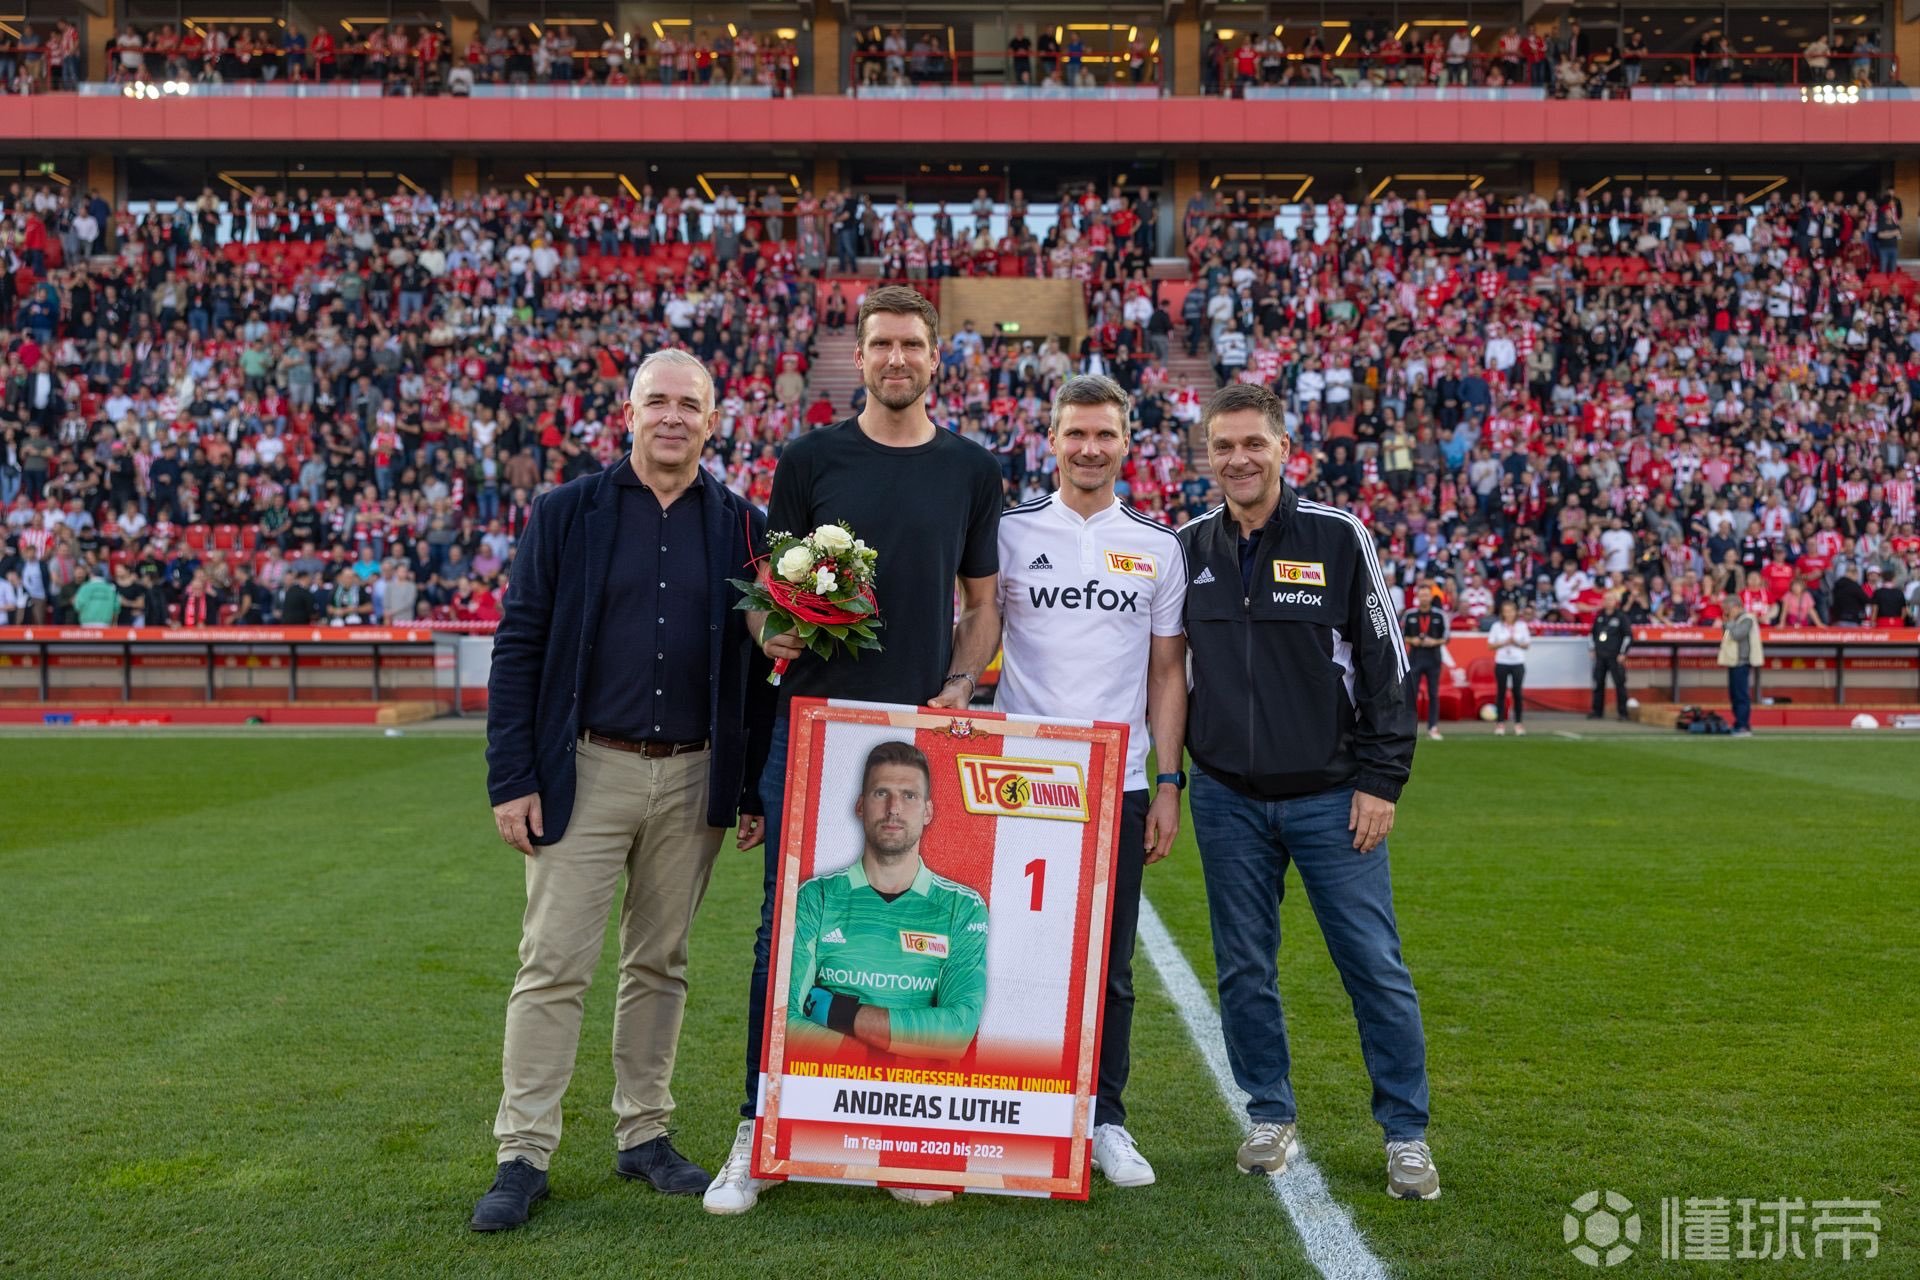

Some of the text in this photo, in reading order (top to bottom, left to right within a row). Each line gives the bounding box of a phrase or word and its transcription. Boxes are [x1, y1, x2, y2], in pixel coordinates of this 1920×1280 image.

[1029, 562, 1053, 570] adidas
[1134, 563, 1153, 573] UNION
[1302, 571, 1321, 581] UNION
[1193, 575, 1216, 585] adidas
[1029, 579, 1139, 613] wefox
[1272, 590, 1323, 607] wefox
[1369, 608, 1385, 640] CENTRAL
[1375, 606, 1389, 636] COMEDY
[1030, 782, 1081, 809] UNION
[1023, 857, 1047, 912] 1
[821, 935, 847, 944] adidas
[928, 942, 947, 954] UNION
[817, 967, 938, 992] AROUNDTOWN
[789, 1060, 1071, 1095] UND NIEMALS VERGESSEN: EISERN UNION!
[833, 1089, 1022, 1125] ANDREAS LUTHE
[843, 1134, 1004, 1159] im Team von 2020 bis 2022
